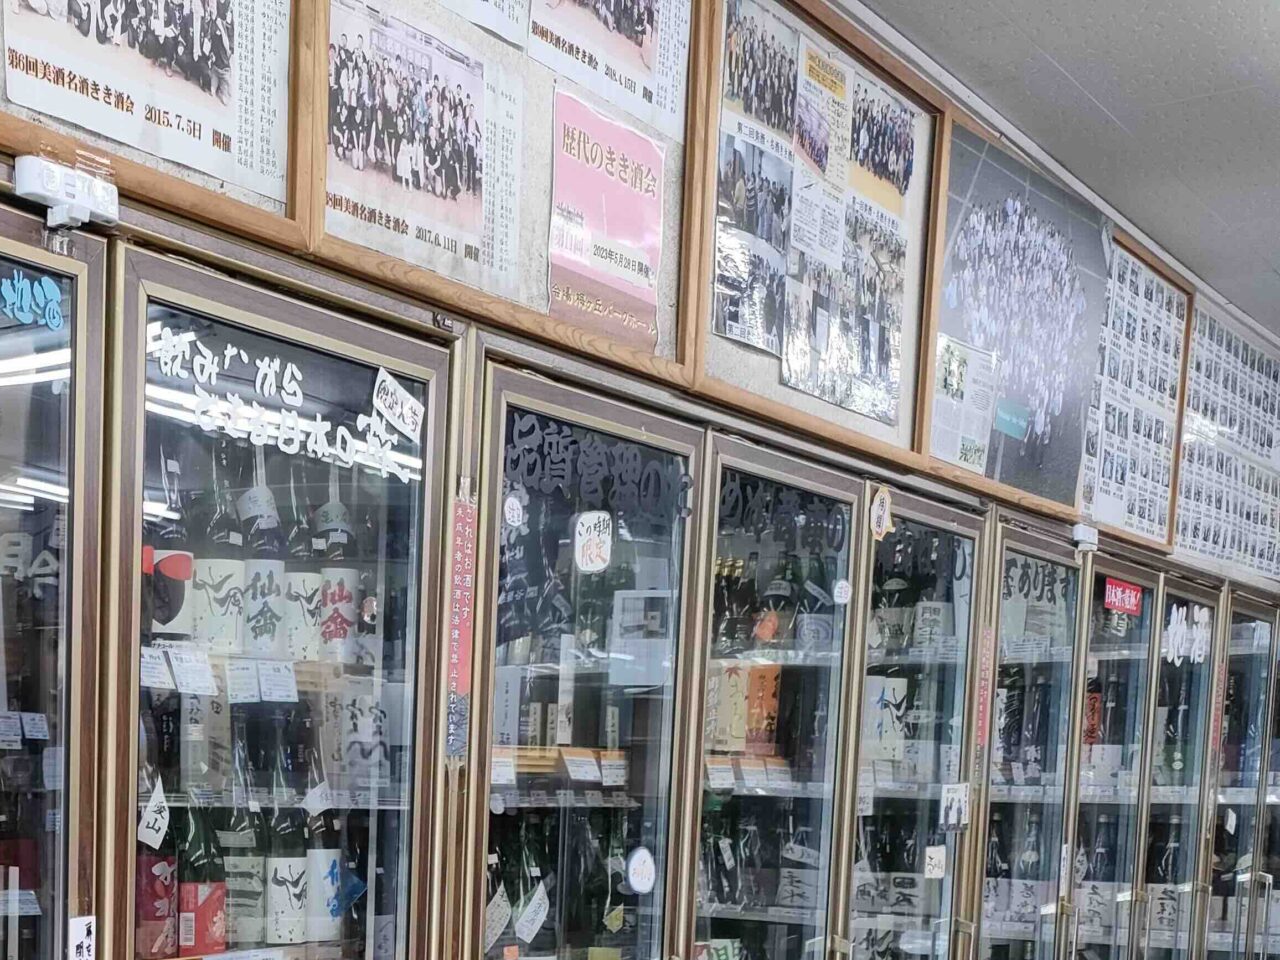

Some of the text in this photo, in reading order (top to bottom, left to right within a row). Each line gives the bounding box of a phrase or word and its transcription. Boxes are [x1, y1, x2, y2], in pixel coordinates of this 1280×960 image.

[7, 46, 136, 114] 第6回美酒名酒きき酒会
[211, 129, 233, 153] 開催
[561, 122, 658, 200] 歴代のきき酒会
